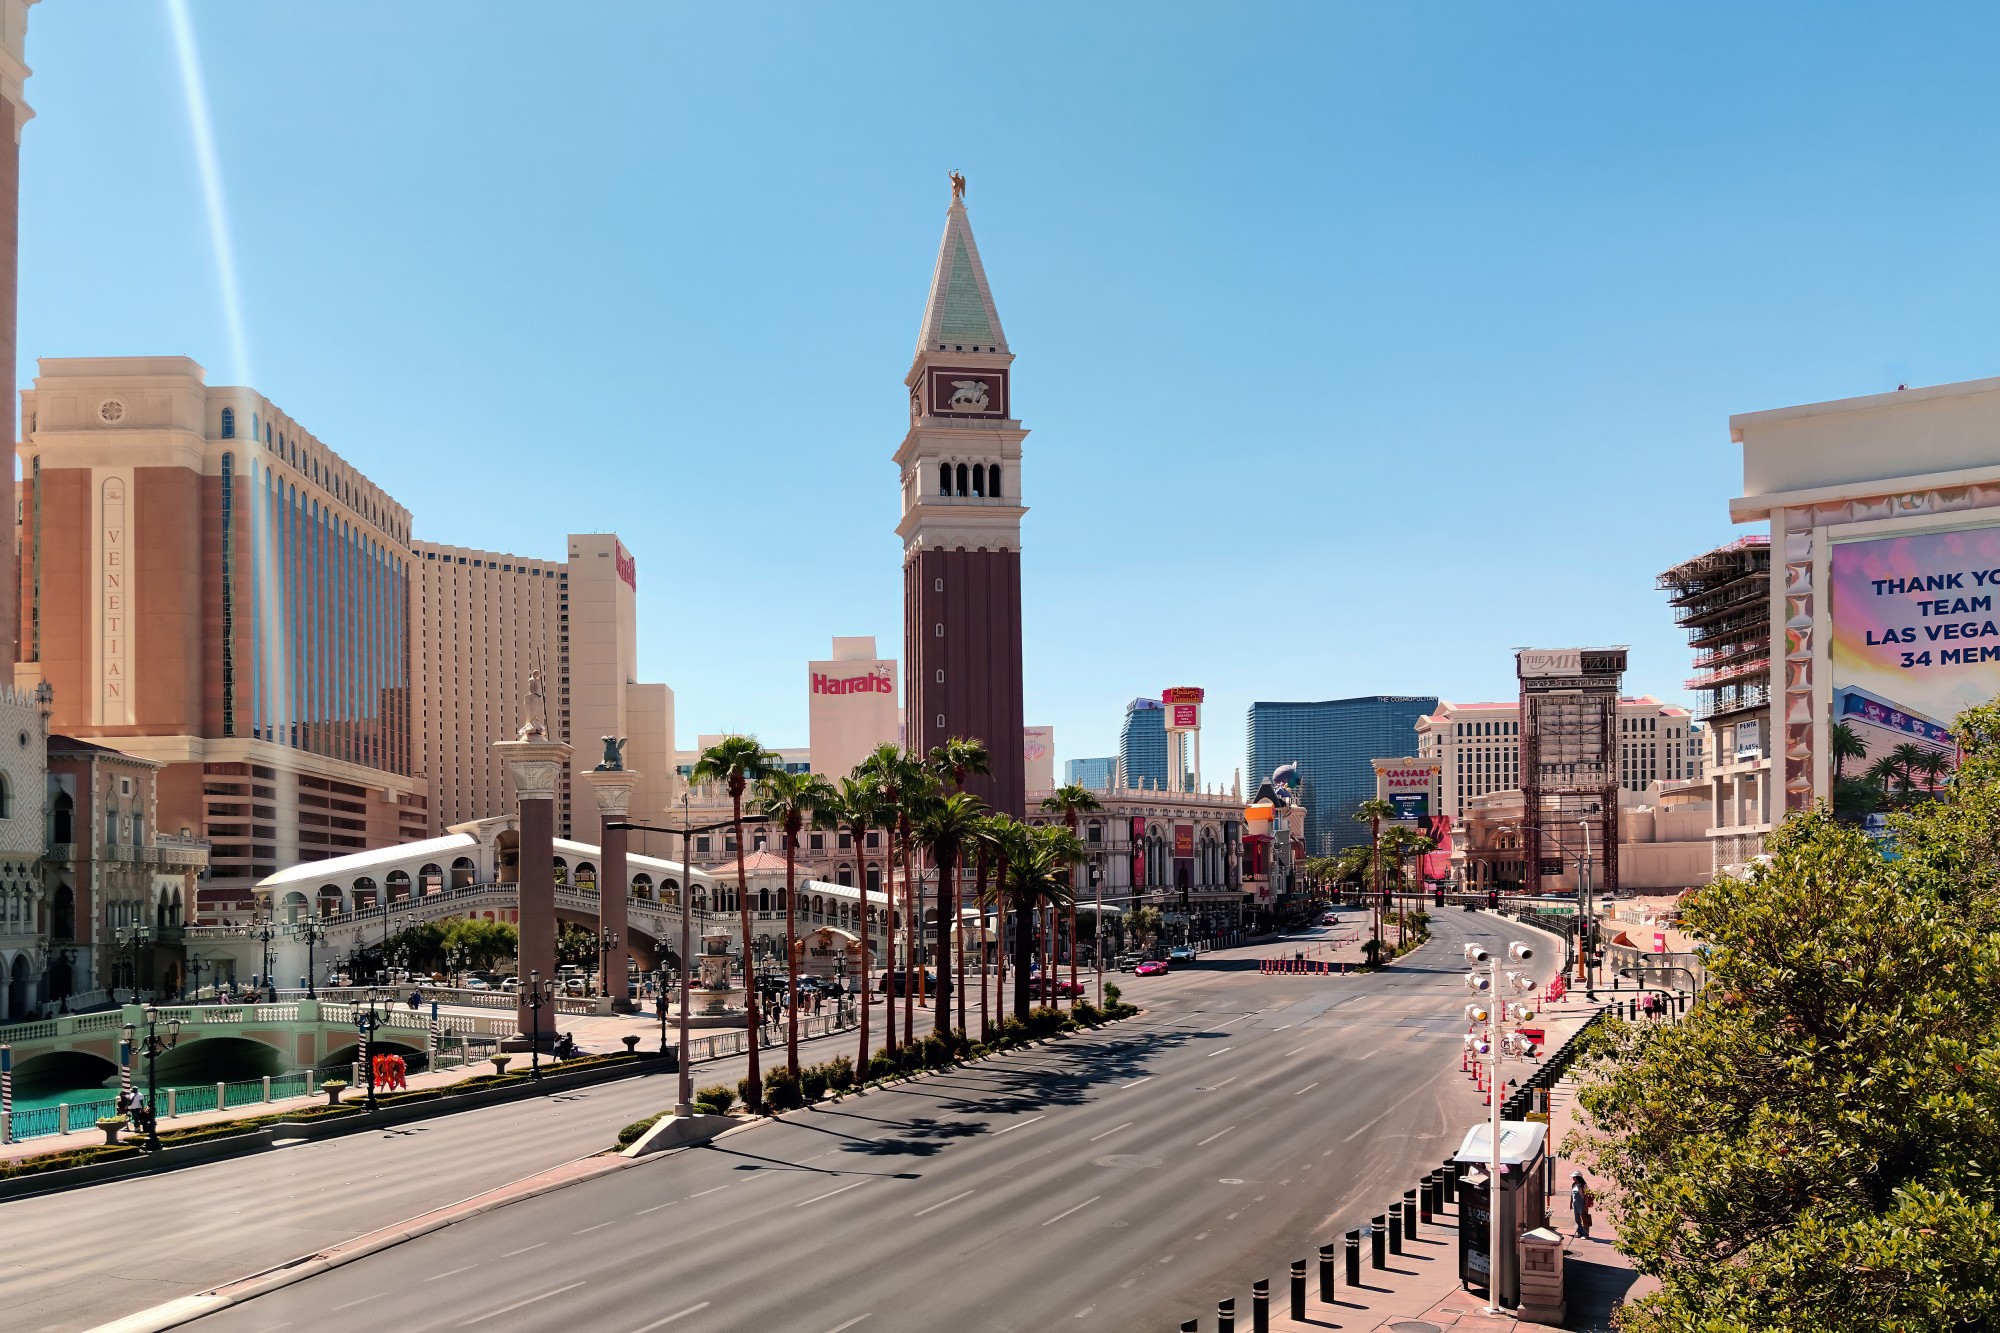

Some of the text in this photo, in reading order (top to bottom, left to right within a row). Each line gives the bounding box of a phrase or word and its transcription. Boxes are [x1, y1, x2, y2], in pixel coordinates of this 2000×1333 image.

[1872, 568, 2000, 596] THANK YO
[108, 530, 120, 697] VENETIAN
[1917, 595, 1991, 616] TEAM
[1866, 620, 2000, 646] LAS VEGA
[1524, 655, 1545, 664] THE
[1900, 645, 2000, 668] 34 MEM
[1740, 721, 1757, 729] PENTA
[1386, 769, 1431, 777] CAESARS
[1388, 779, 1429, 787] PALACE
